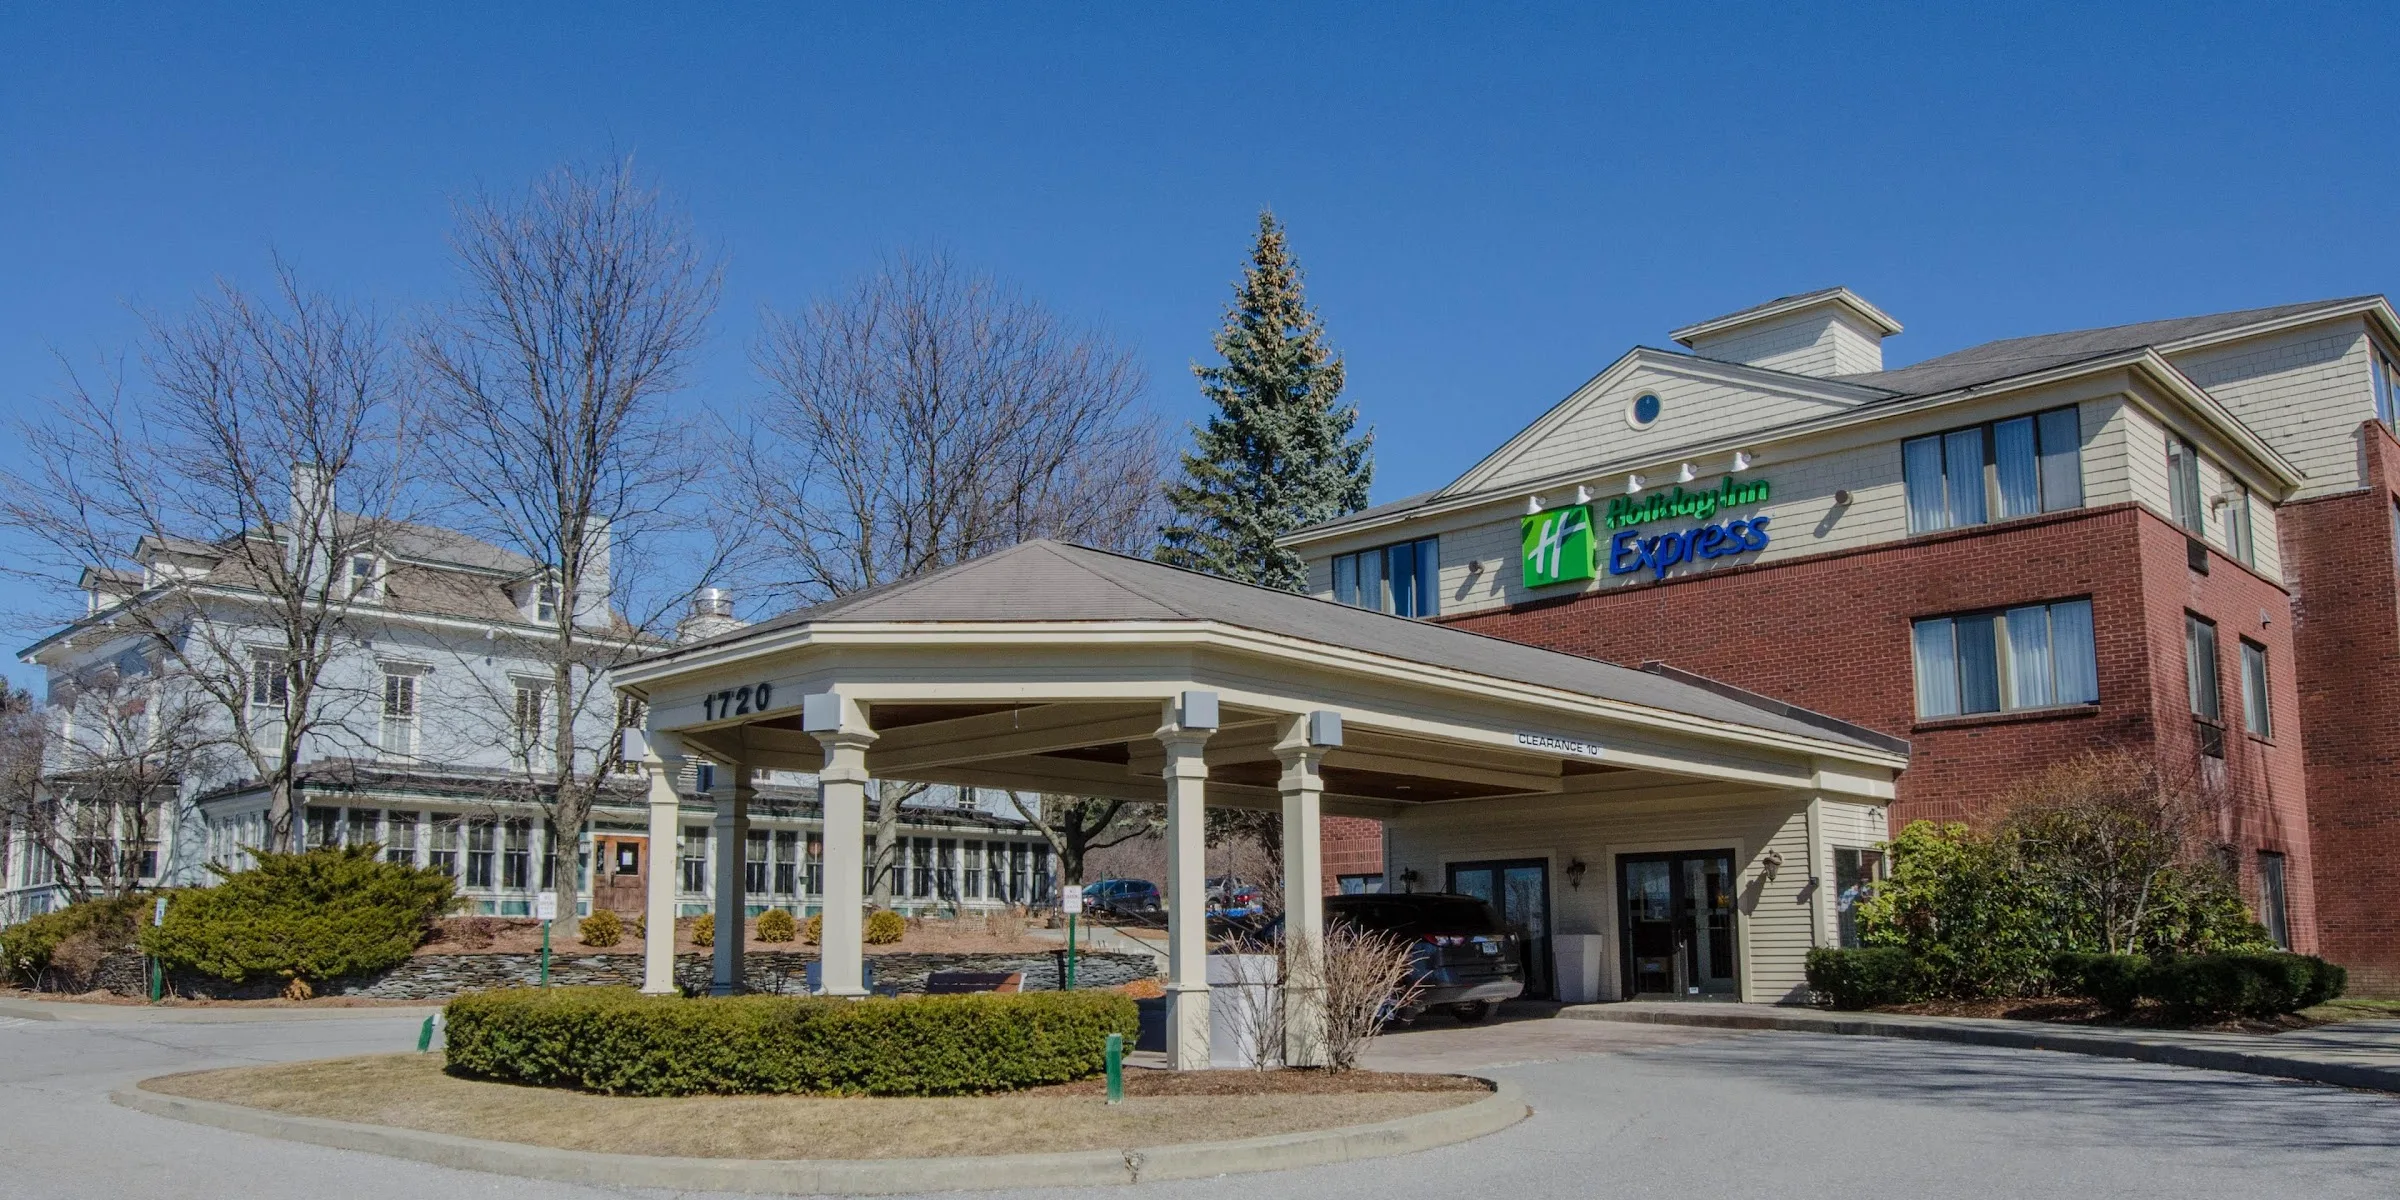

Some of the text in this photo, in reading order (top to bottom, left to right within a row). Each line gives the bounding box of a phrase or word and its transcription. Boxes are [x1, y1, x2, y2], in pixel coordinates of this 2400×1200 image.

[1606, 476, 1769, 529] Holiday Inn
[1609, 516, 1770, 579] Express
[704, 683, 772, 720] 1720
[1518, 733, 1583, 752] CLEARANCE
